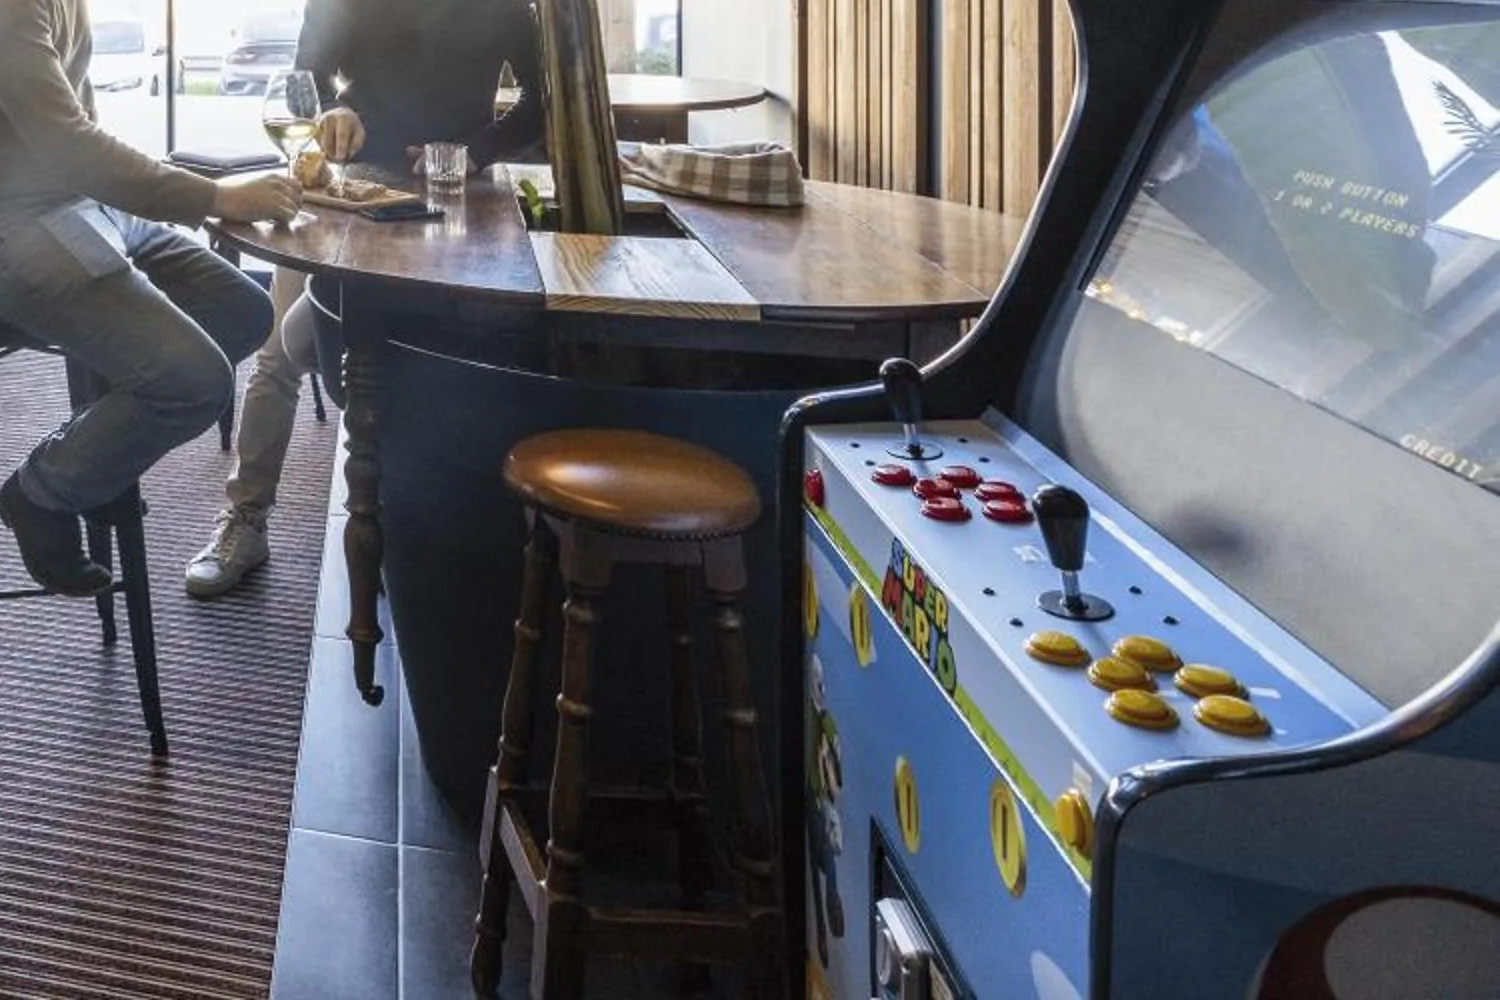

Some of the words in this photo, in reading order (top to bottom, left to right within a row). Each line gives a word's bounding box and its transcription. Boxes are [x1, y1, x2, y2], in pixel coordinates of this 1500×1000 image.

[1292, 168, 1336, 190] PUSH
[1339, 180, 1410, 210] BUTTON
[1291, 194, 1314, 210] OR
[1337, 206, 1422, 239] PLAYERS
[1400, 432, 1484, 479] CREDIT
